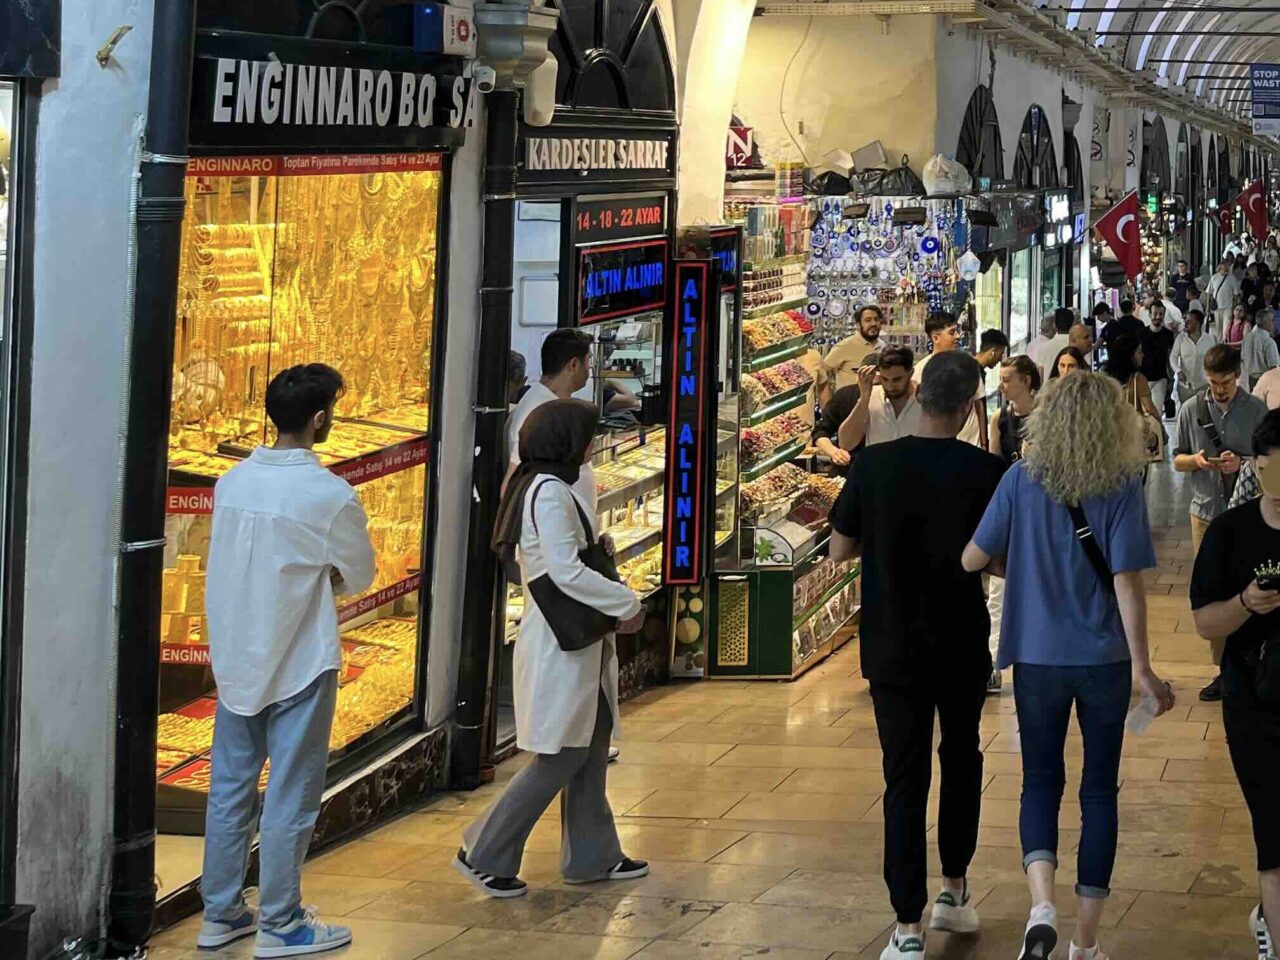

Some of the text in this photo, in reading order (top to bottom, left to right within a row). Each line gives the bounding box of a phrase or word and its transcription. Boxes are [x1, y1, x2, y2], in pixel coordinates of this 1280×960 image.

[1253, 70, 1279, 79] STOP
[213, 58, 479, 129] ENGINNARO BOSA
[617, 139, 669, 170] SARRAF
[728, 128, 753, 158] N
[730, 152, 747, 167] 12
[577, 212, 590, 231] 14
[600, 209, 612, 229] 18
[620, 208, 634, 227] 22
[635, 206, 661, 225] AYAR
[585, 262, 664, 298] ALTIN ALINIR
[676, 278, 698, 567] ALTIN ALINIR
